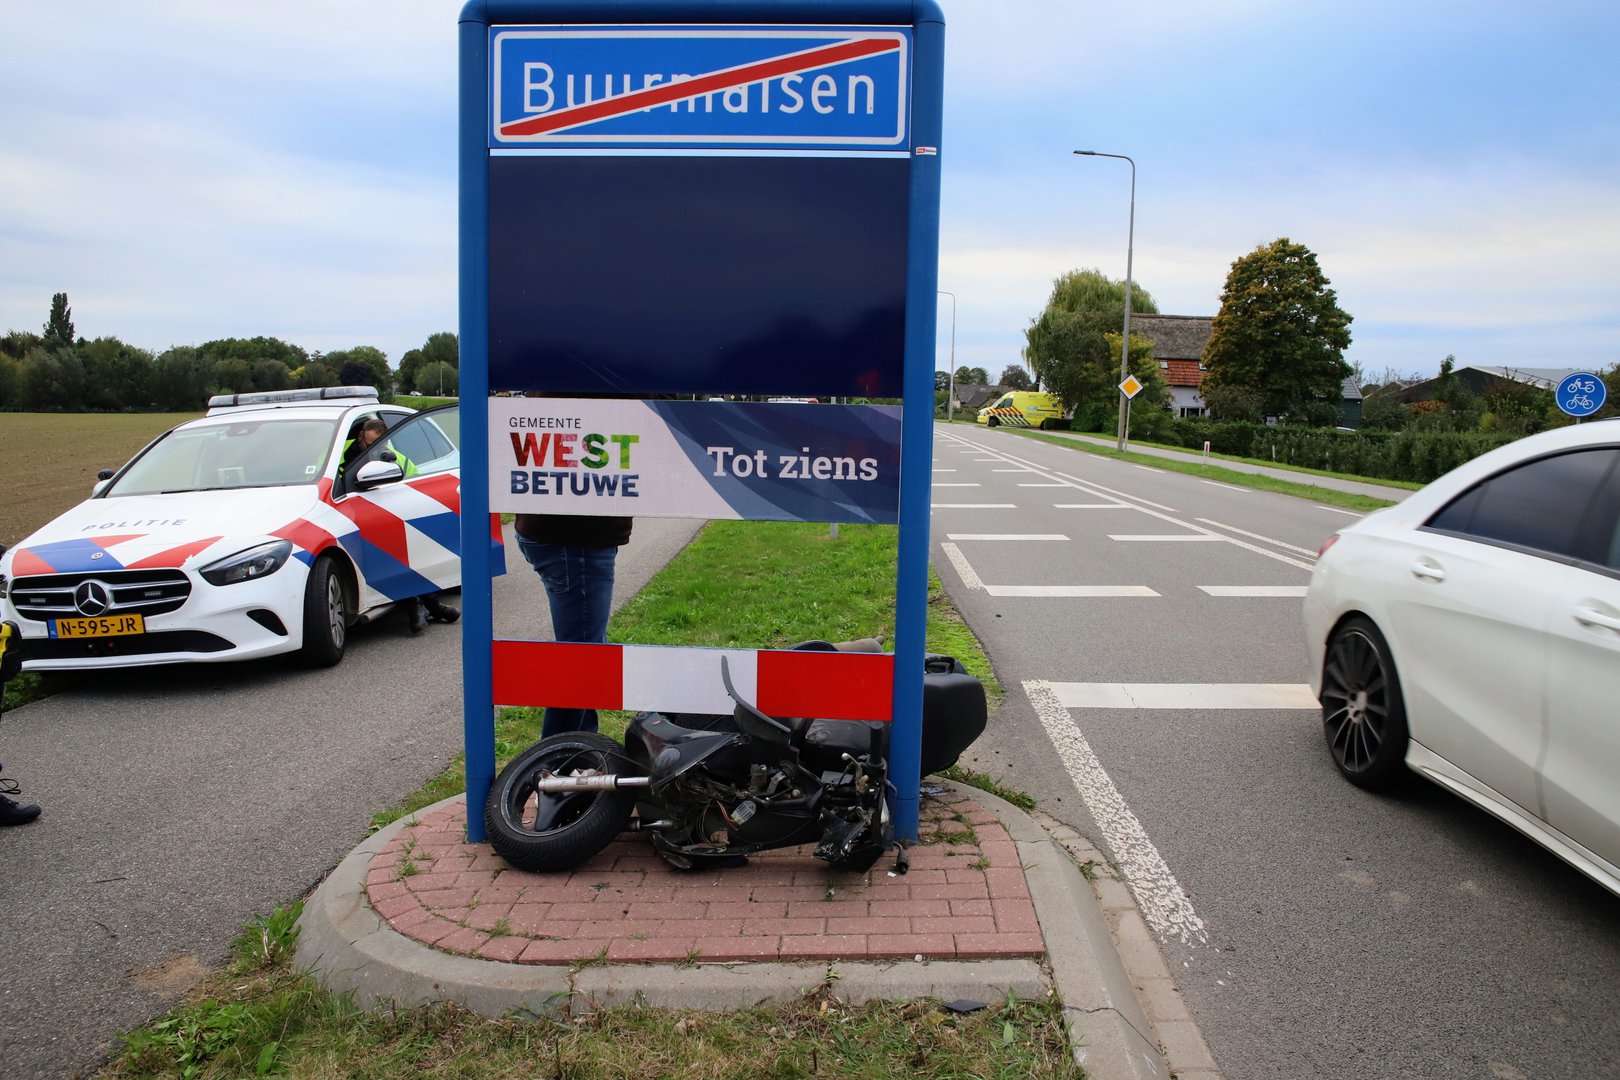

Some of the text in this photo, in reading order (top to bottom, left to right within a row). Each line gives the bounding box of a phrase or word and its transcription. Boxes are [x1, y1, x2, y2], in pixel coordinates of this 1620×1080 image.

[509, 416, 582, 429] GEMEENTE
[509, 432, 640, 470] WEST
[706, 446, 879, 481] Tot ziens
[510, 470, 640, 498] BETUWE
[81, 518, 187, 532] POLITIE
[60, 617, 138, 636] N-595-JR
